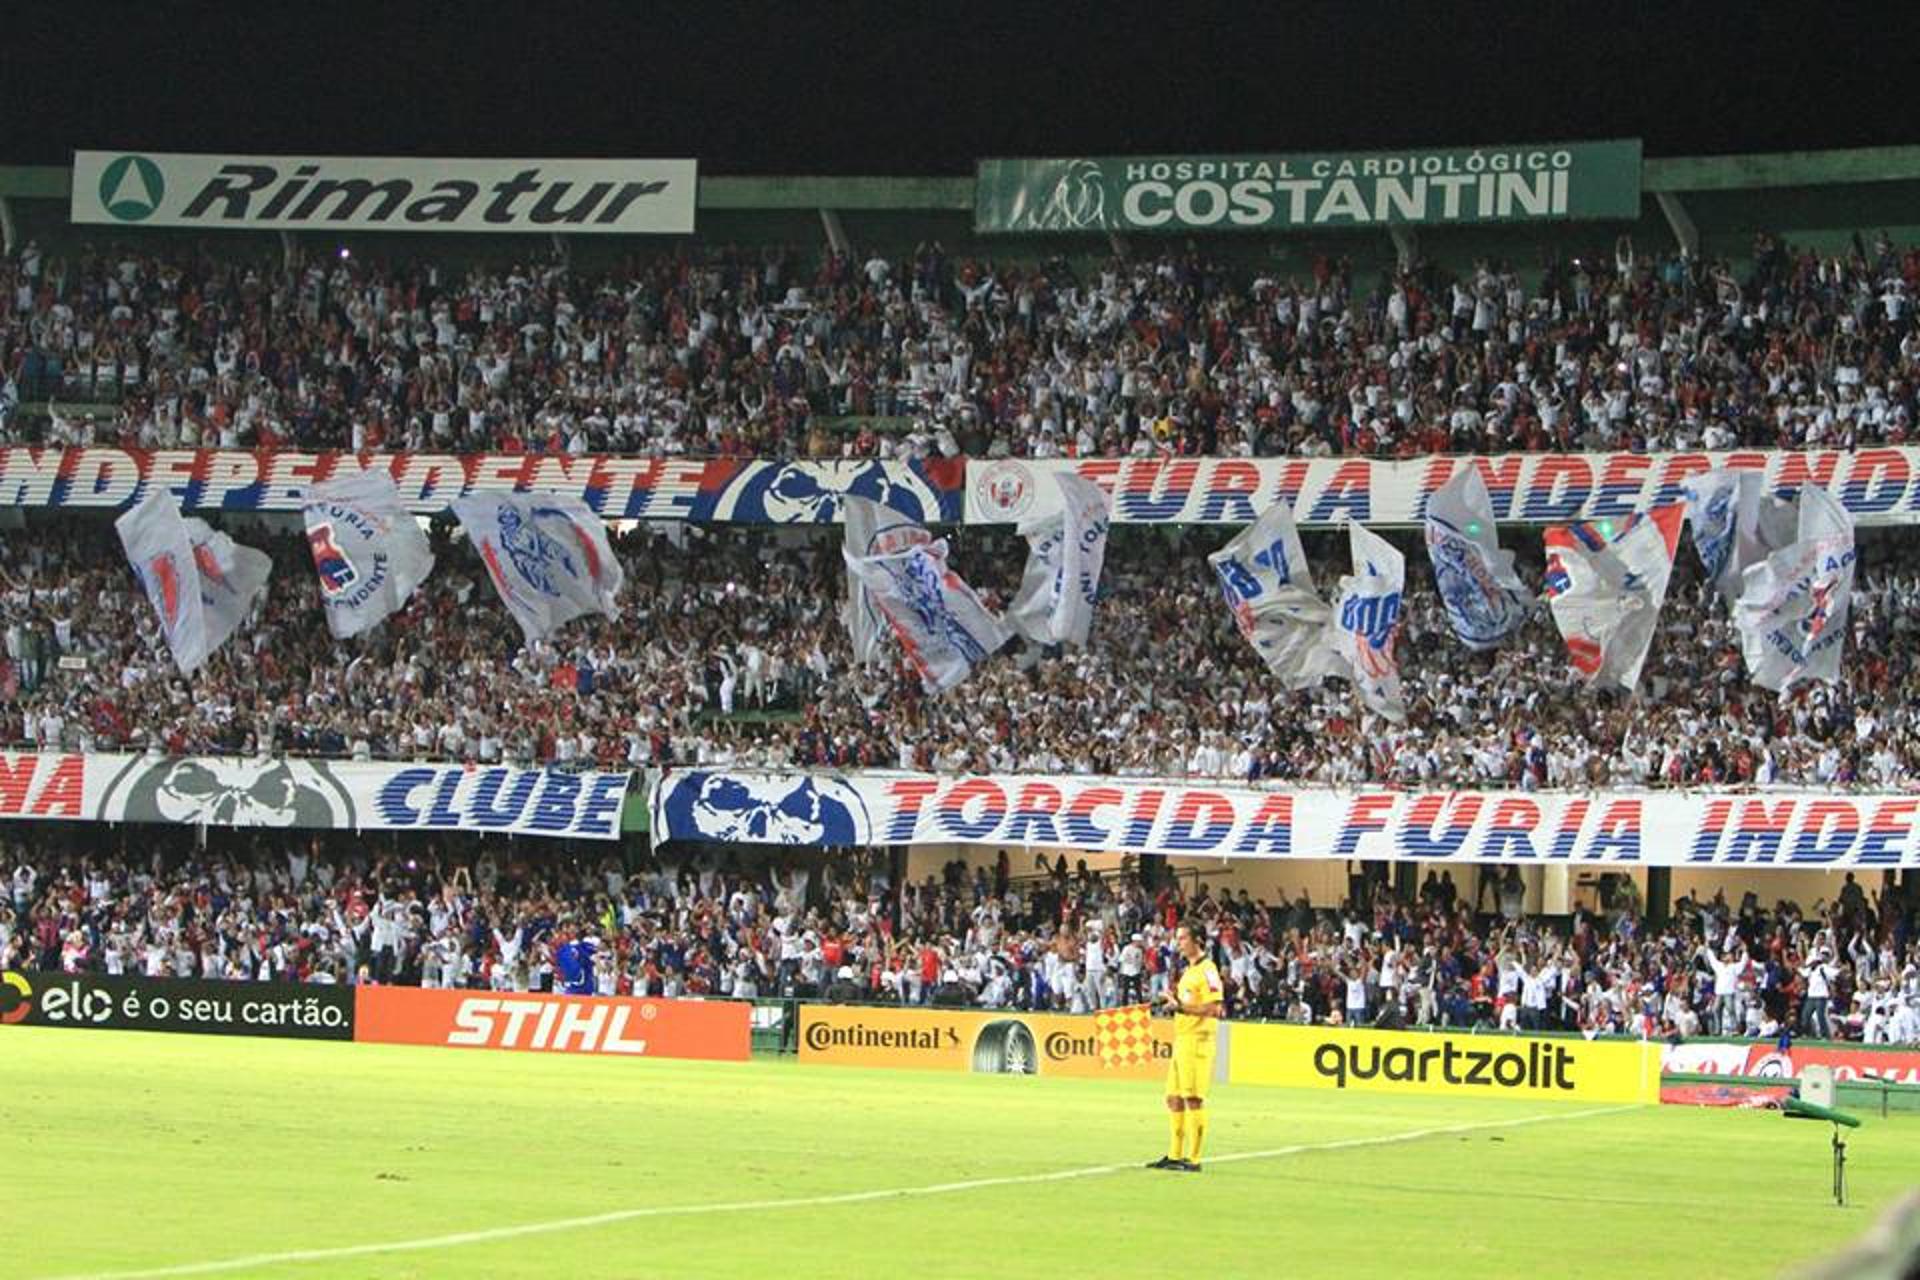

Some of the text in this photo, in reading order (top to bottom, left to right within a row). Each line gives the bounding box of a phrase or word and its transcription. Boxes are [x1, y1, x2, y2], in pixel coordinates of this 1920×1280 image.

[1126, 150, 1572, 181] HOSPITAL CARDIOLÓGICO
[180, 165, 670, 224] Rimatur
[1123, 170, 1569, 226] COSTANTINI
[376, 769, 628, 834] CLUBE
[883, 778, 1293, 854] TORCIDA
[1686, 800, 1920, 863] INDE
[41, 981, 349, 1028] elo é o seu cartão.
[806, 1021, 939, 1051] Continental
[1313, 1041, 1575, 1090] quartzolit
